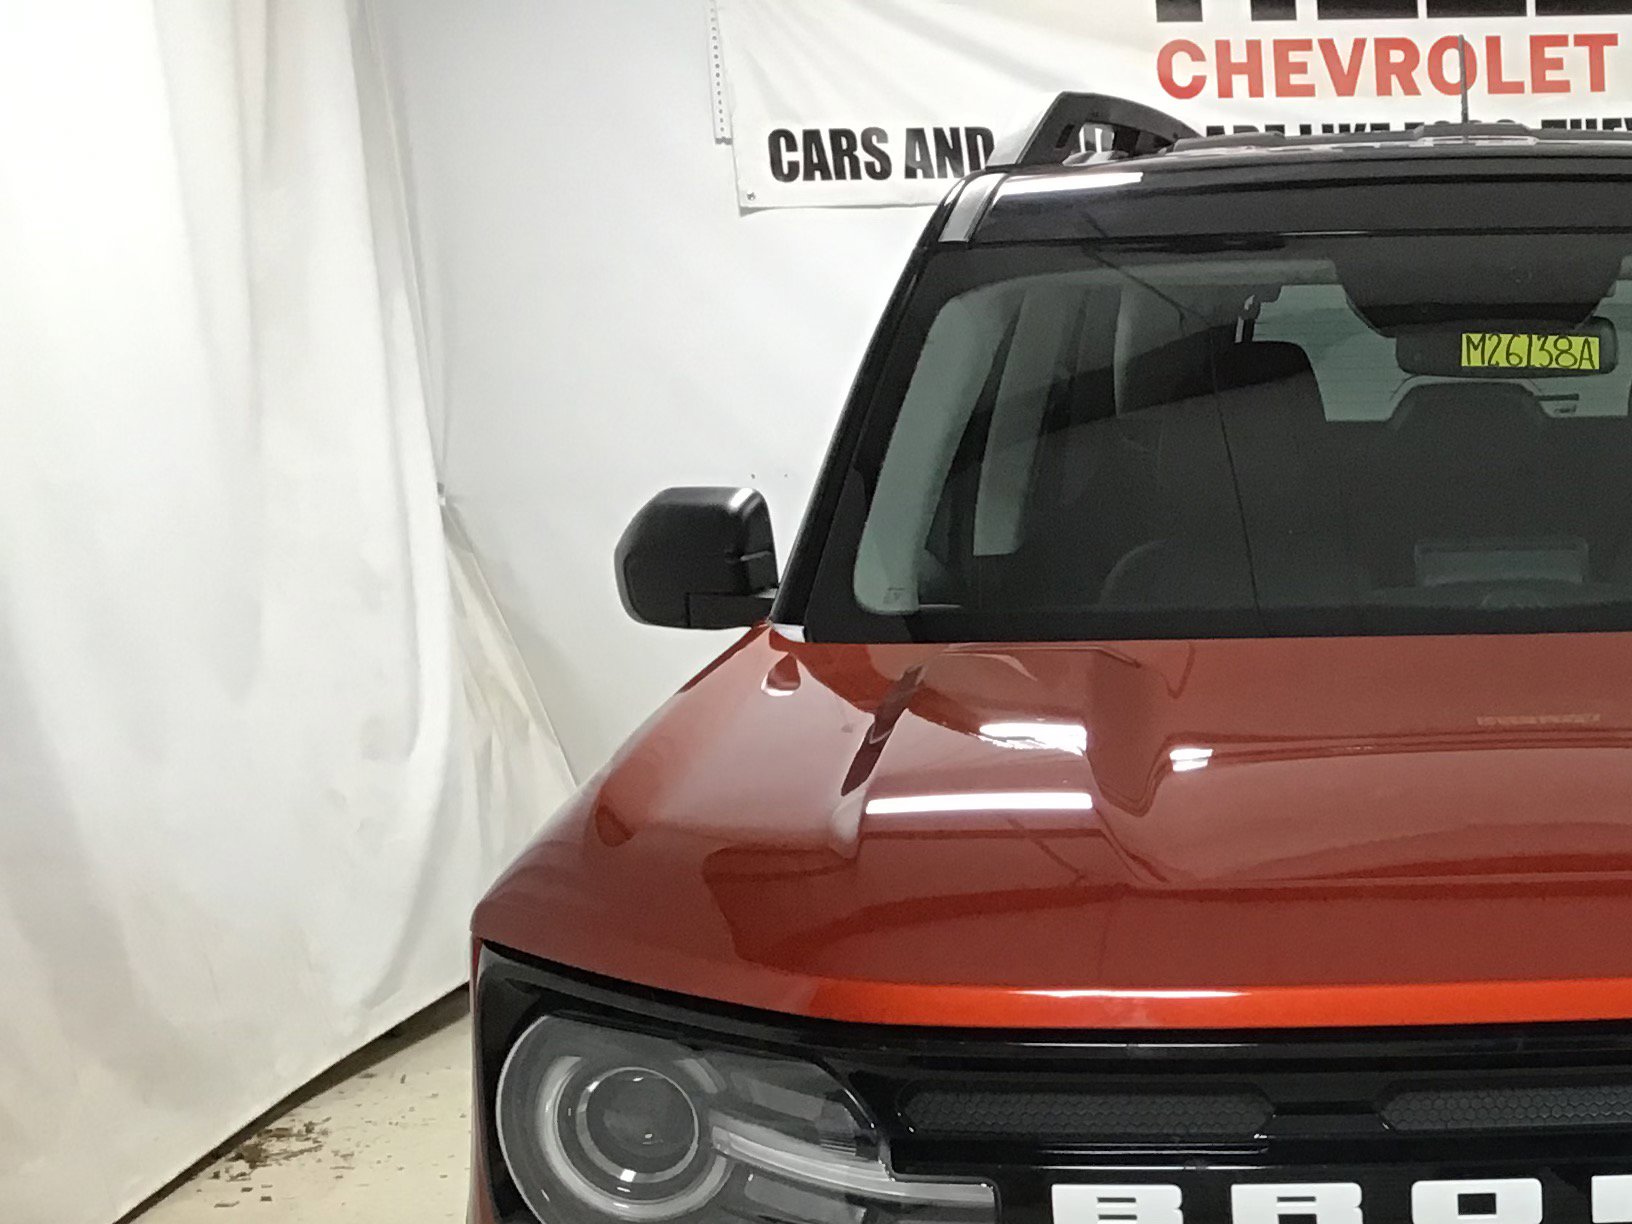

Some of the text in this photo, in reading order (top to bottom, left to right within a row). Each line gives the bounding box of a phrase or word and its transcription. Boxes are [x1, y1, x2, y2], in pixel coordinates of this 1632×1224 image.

[1156, 33, 1619, 99] CHEVROLET
[768, 127, 892, 183] CARS
[904, 126, 995, 179] AND
[1465, 334, 1596, 370] M26138A
